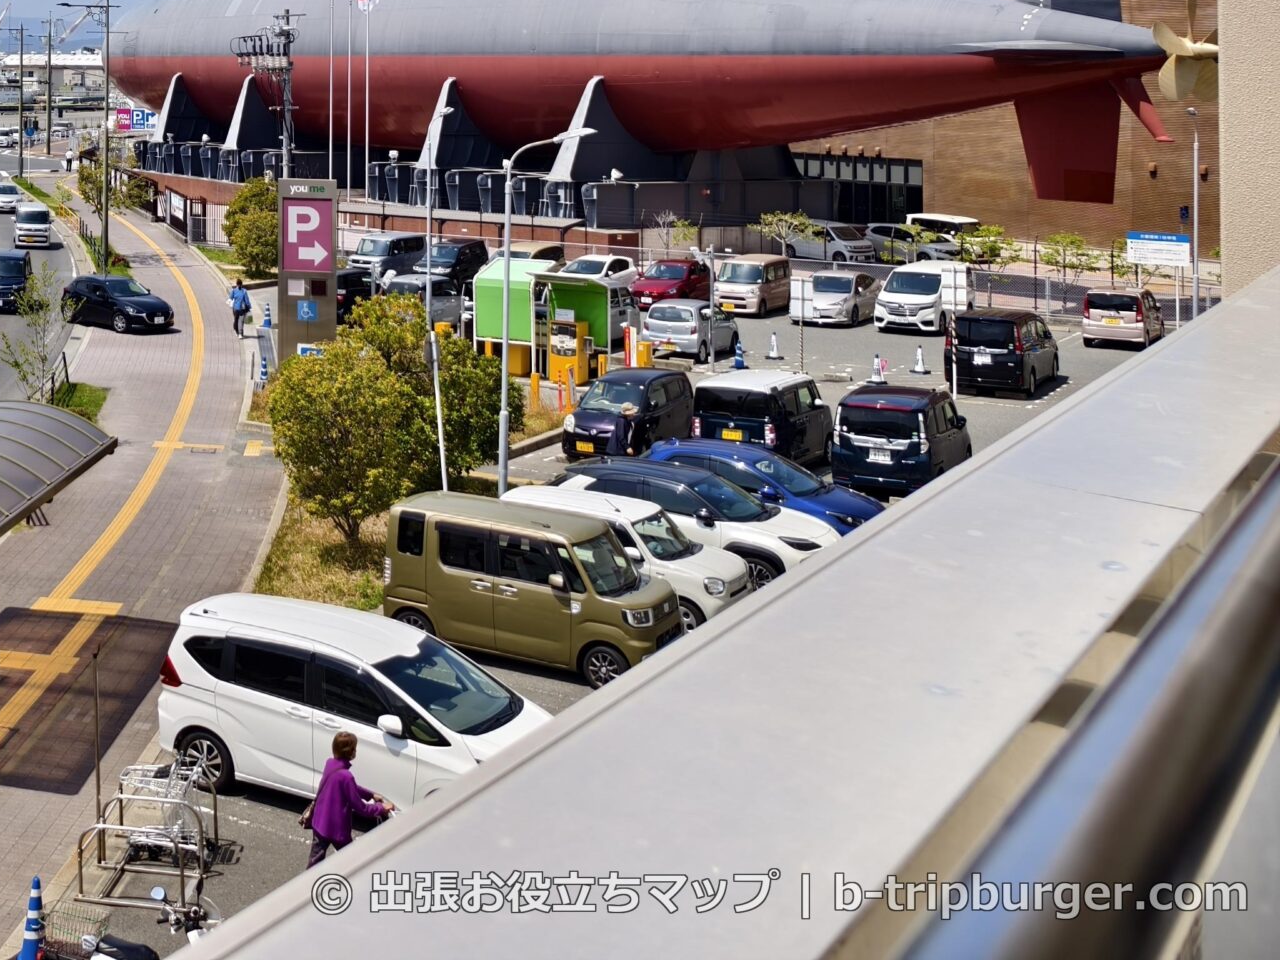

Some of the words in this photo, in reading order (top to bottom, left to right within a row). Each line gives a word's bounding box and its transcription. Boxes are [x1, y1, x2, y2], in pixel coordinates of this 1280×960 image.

[117, 113, 130, 121] you
[133, 111, 142, 124] P
[289, 184, 308, 195] you
[309, 185, 325, 193] me
[287, 205, 321, 243] P
